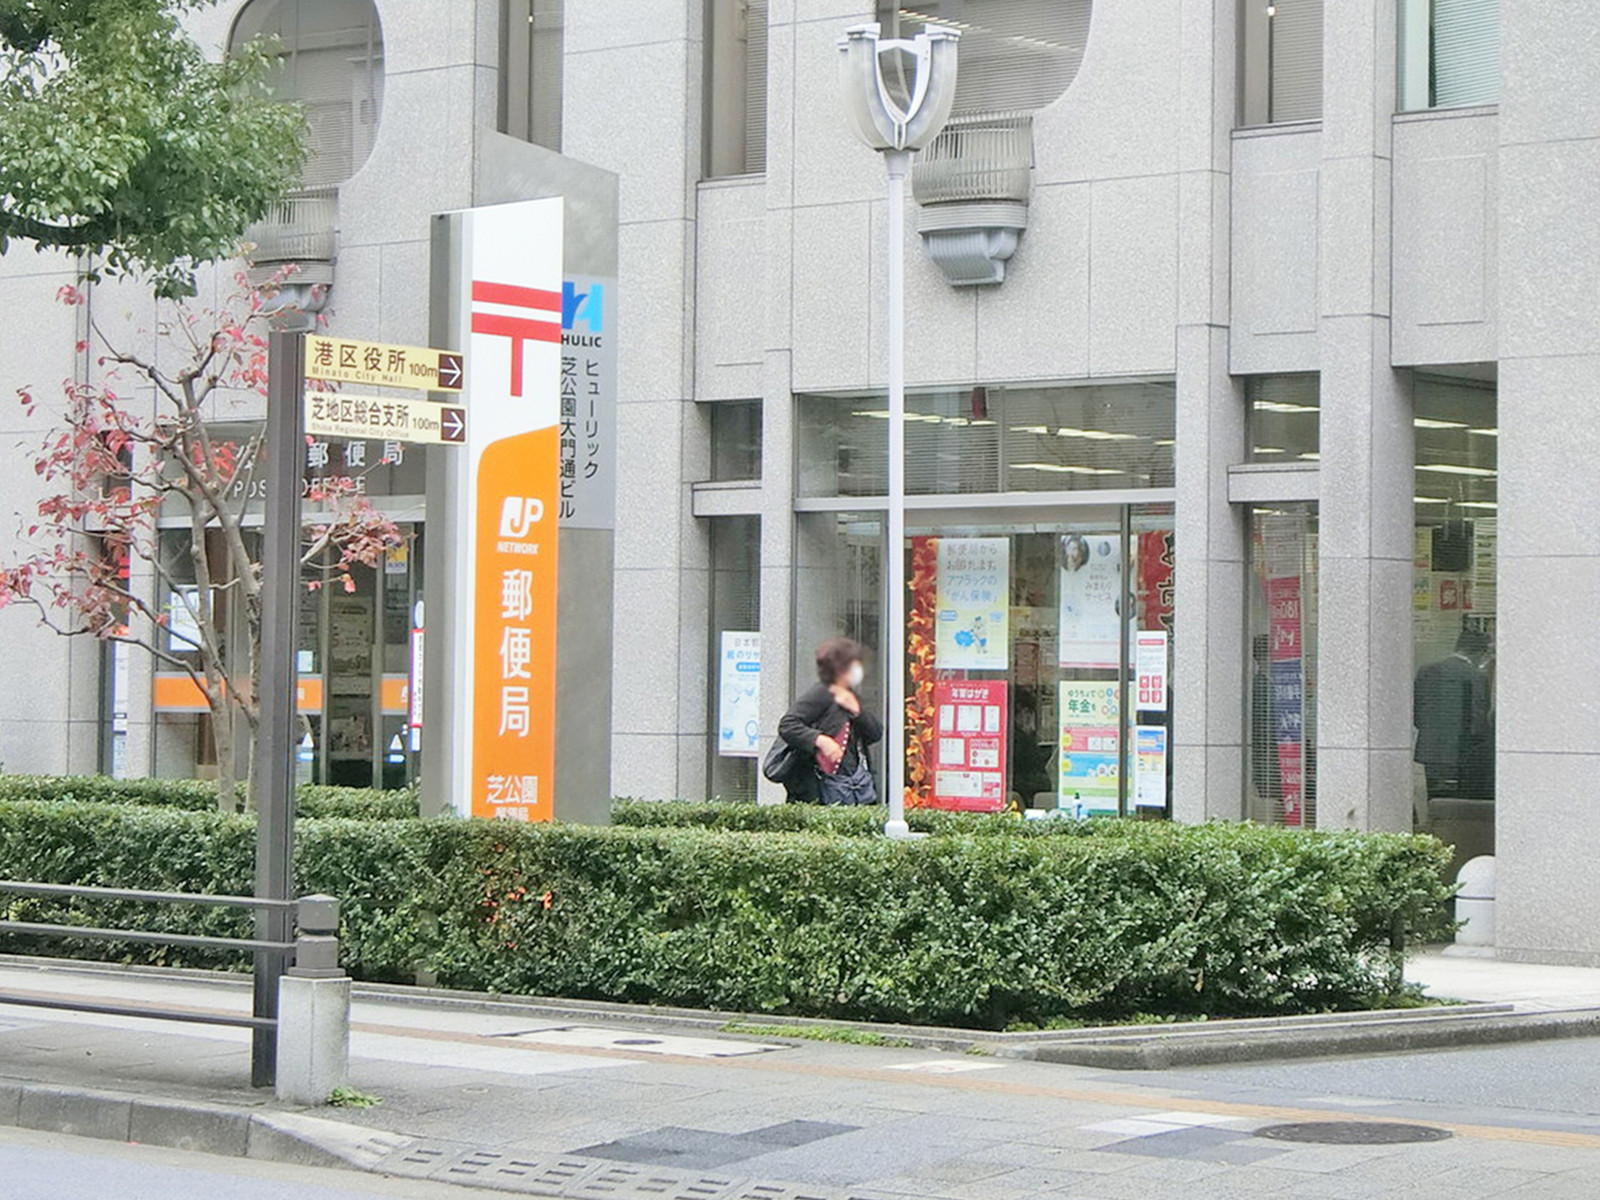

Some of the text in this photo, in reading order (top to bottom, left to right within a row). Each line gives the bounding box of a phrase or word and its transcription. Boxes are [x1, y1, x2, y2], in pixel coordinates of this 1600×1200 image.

[561, 334, 602, 348] HULIC
[311, 366, 402, 383] Minato City Hall
[314, 340, 438, 378] 港区役所 100m
[311, 396, 440, 431] 芝地区総合支所 100m
[584, 359, 600, 479] ヒューリック
[558, 356, 577, 519] 芝公園大門通ビル
[496, 541, 540, 556] NETWORK
[498, 568, 533, 738] 郵便局
[486, 774, 538, 804] 芝公園
